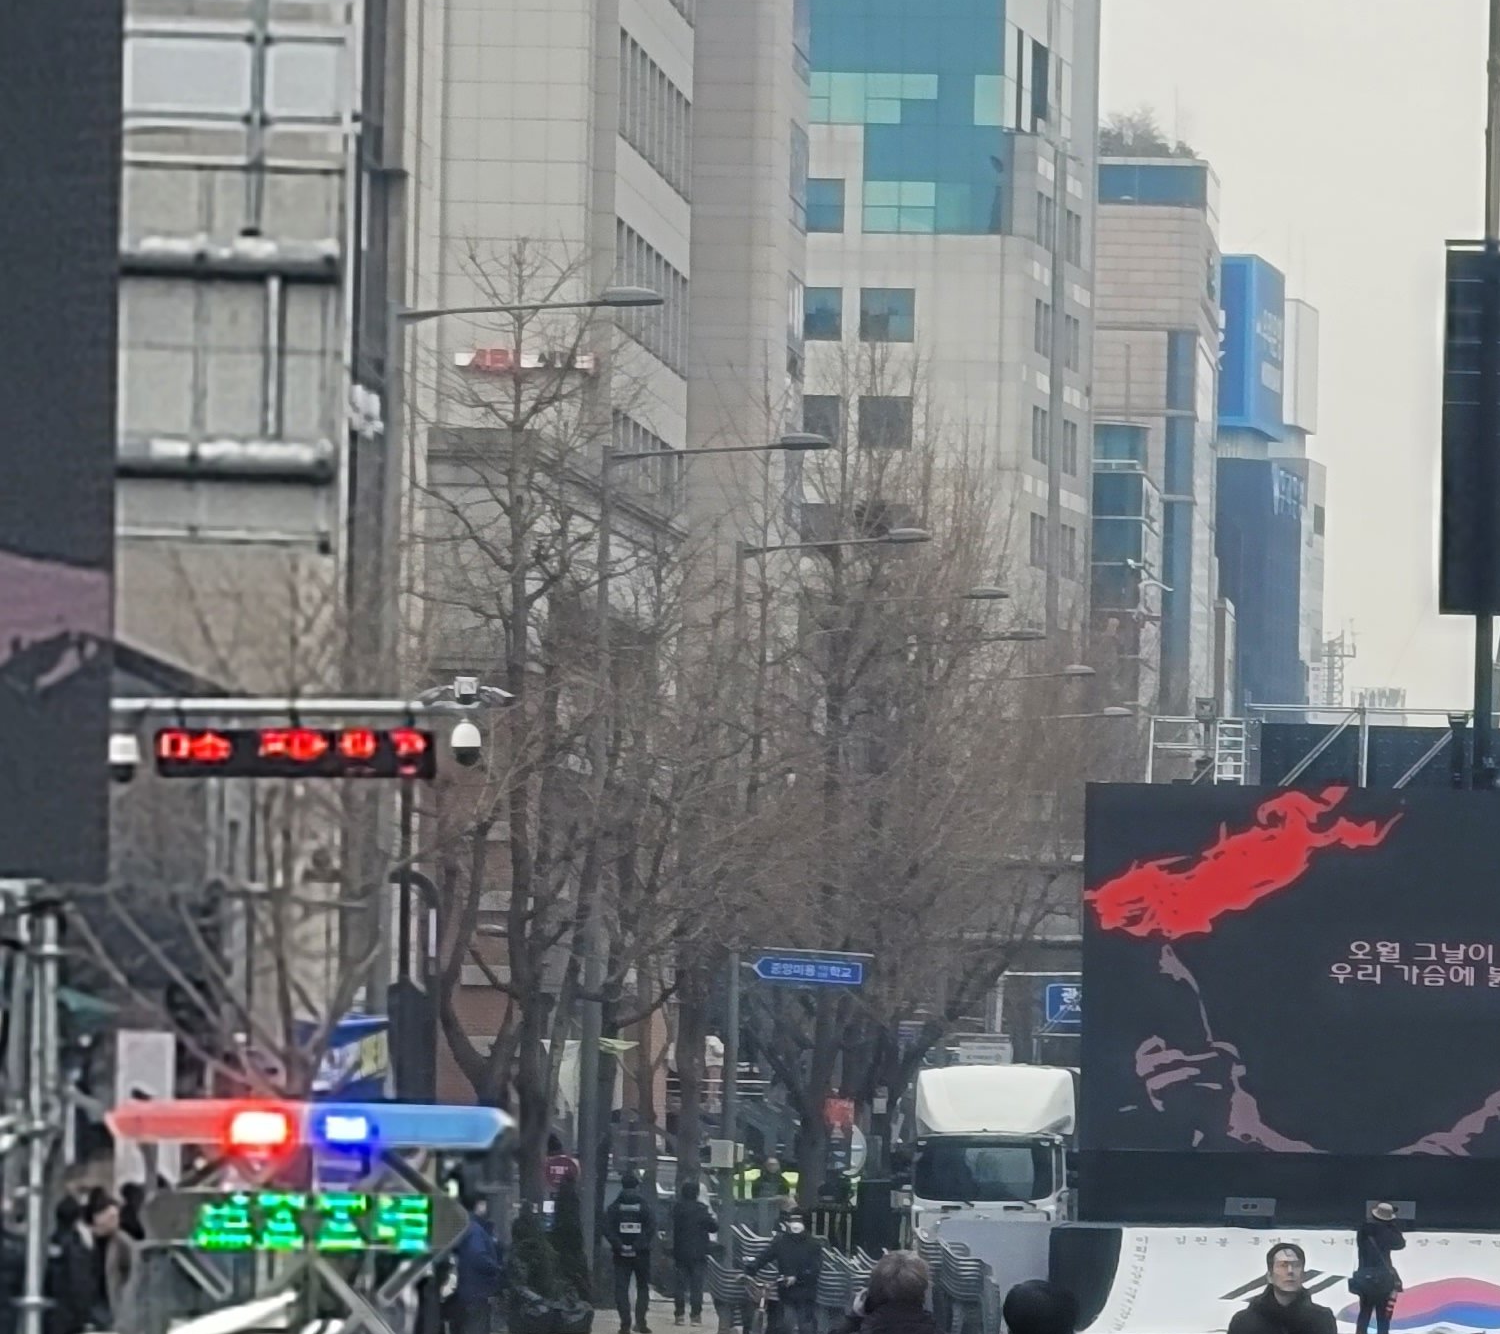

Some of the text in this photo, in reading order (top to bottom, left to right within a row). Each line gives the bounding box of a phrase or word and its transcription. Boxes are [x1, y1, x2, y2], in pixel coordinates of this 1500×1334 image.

[1348, 940, 1401, 964] 오월
[1412, 942, 1494, 965] 그날이
[1328, 962, 1381, 985] 우리
[1393, 964, 1476, 987] 가슴에
